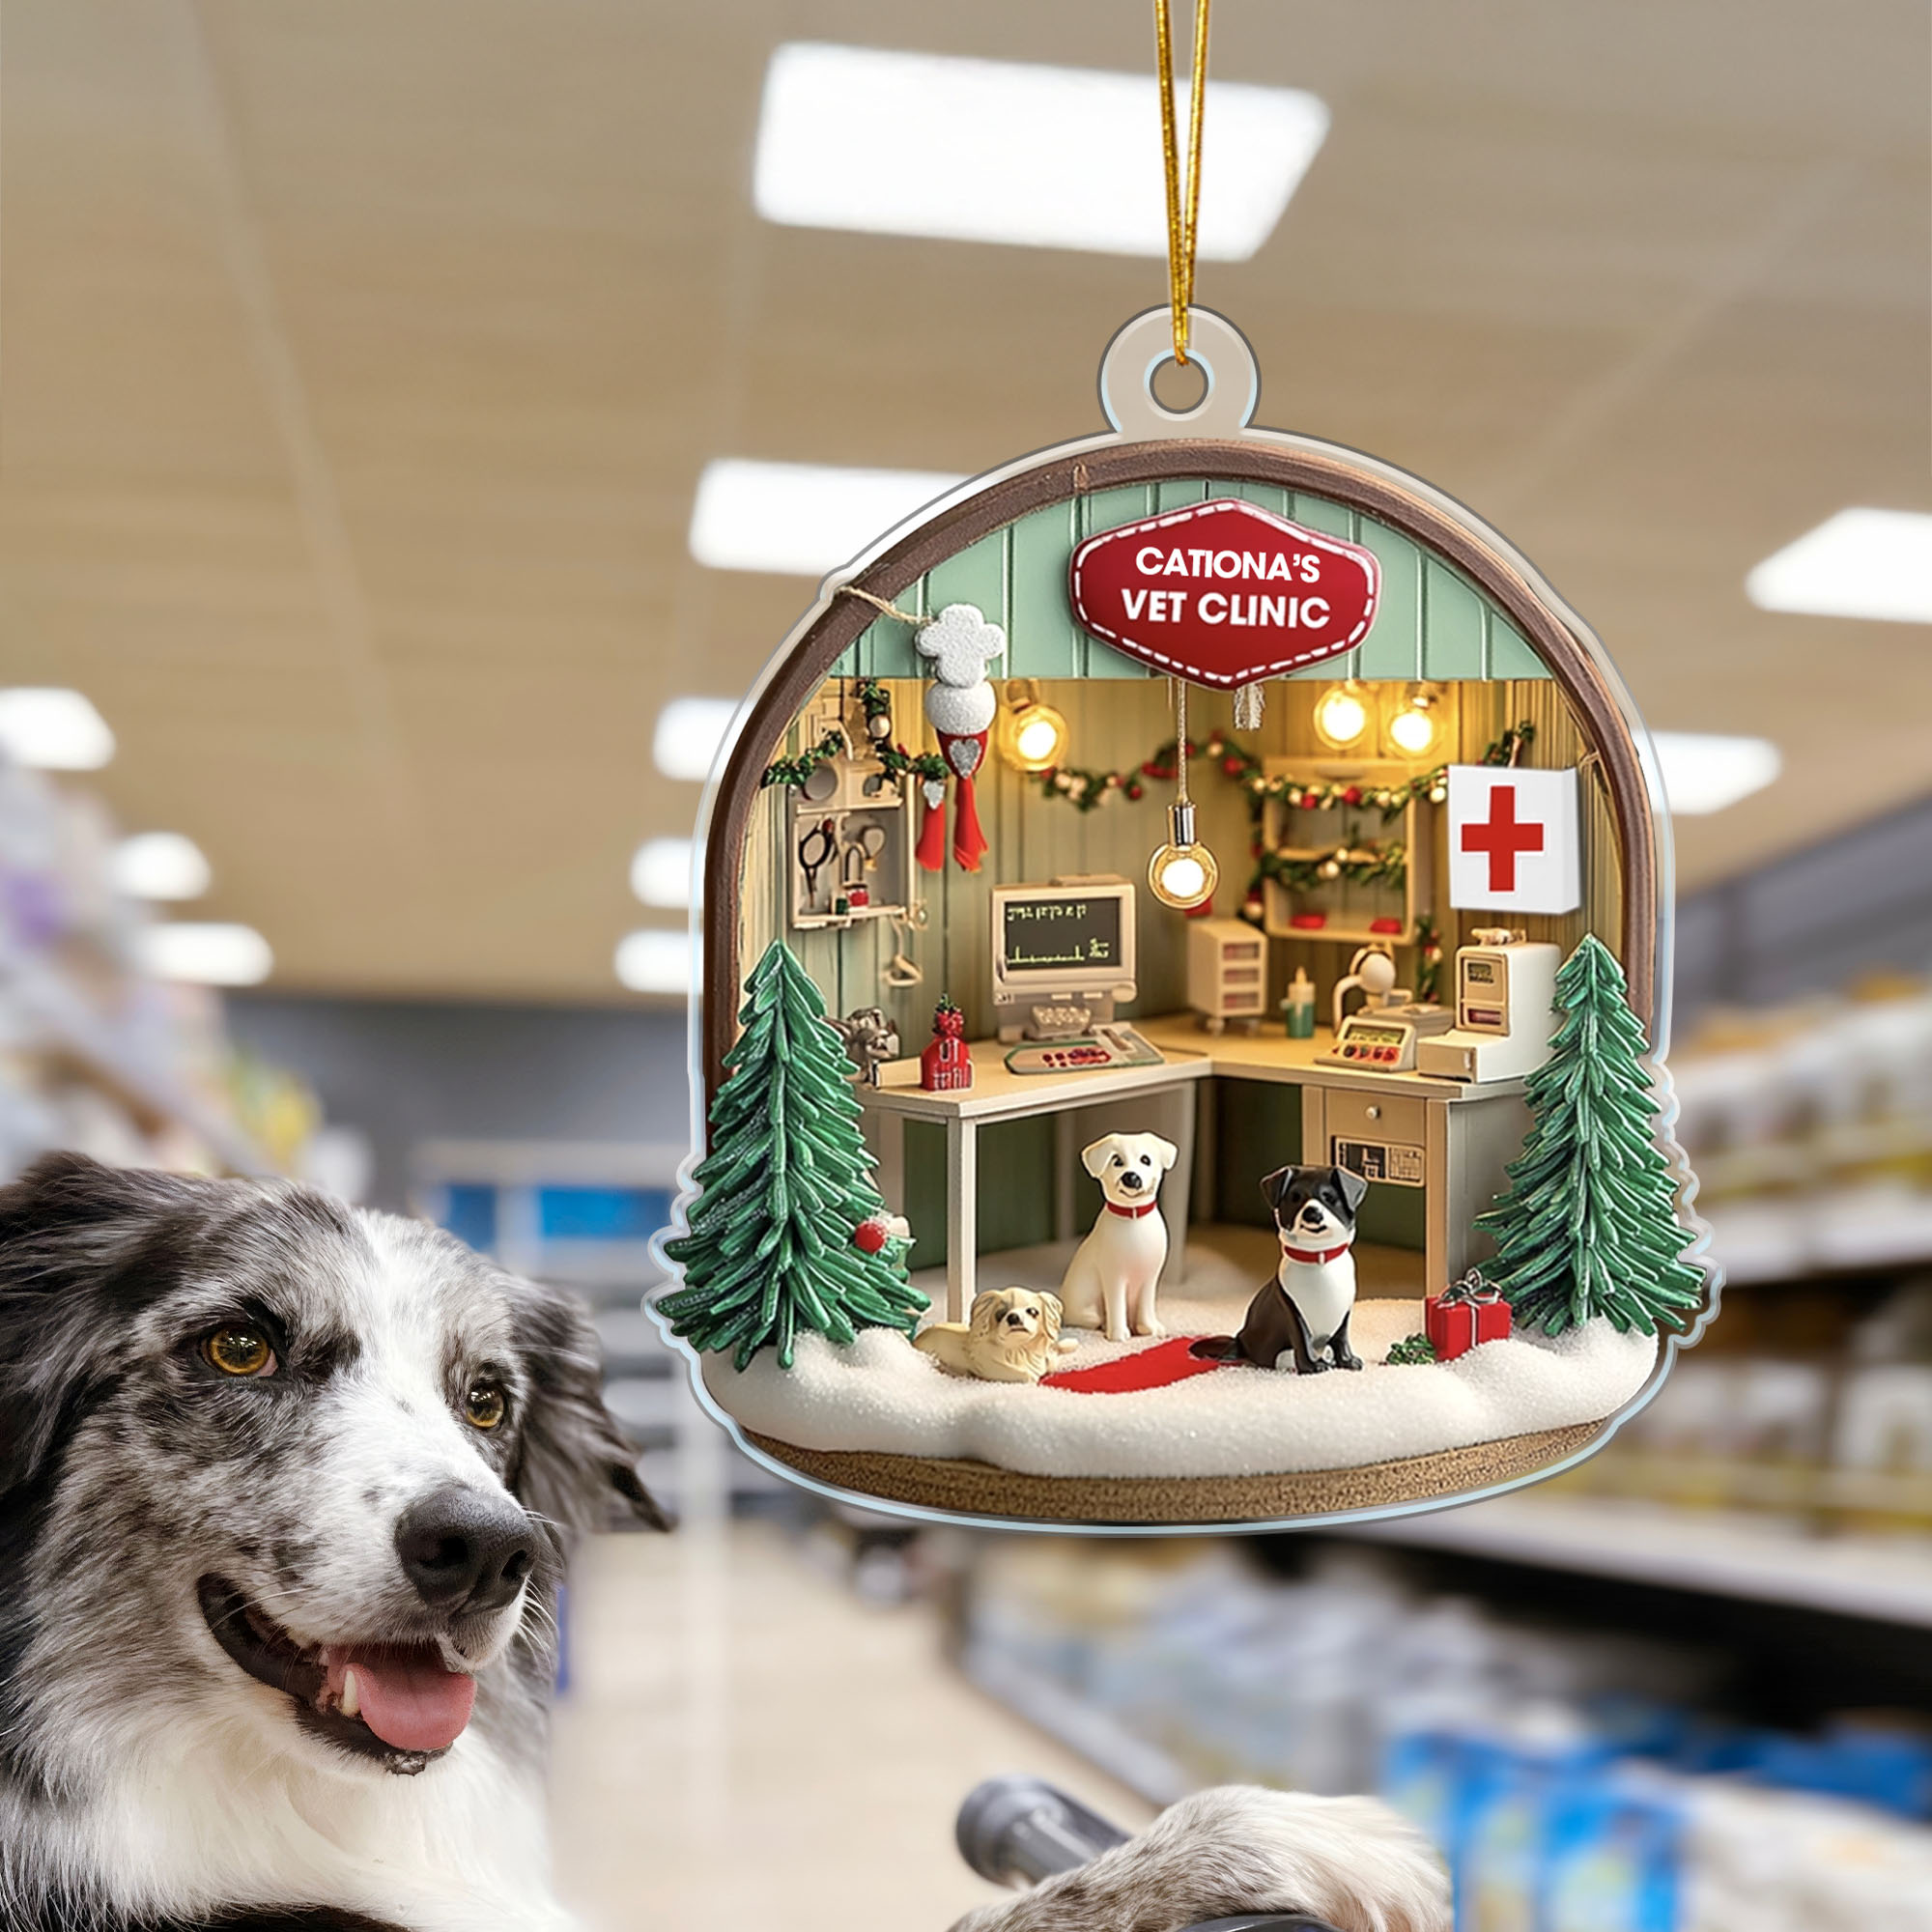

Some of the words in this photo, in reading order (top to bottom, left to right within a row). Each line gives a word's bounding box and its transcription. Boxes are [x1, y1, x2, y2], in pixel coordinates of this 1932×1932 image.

[1135, 546, 1321, 583] CATIONA'S
[1122, 588, 1187, 622] VET
[1197, 592, 1331, 629] CLINIC
